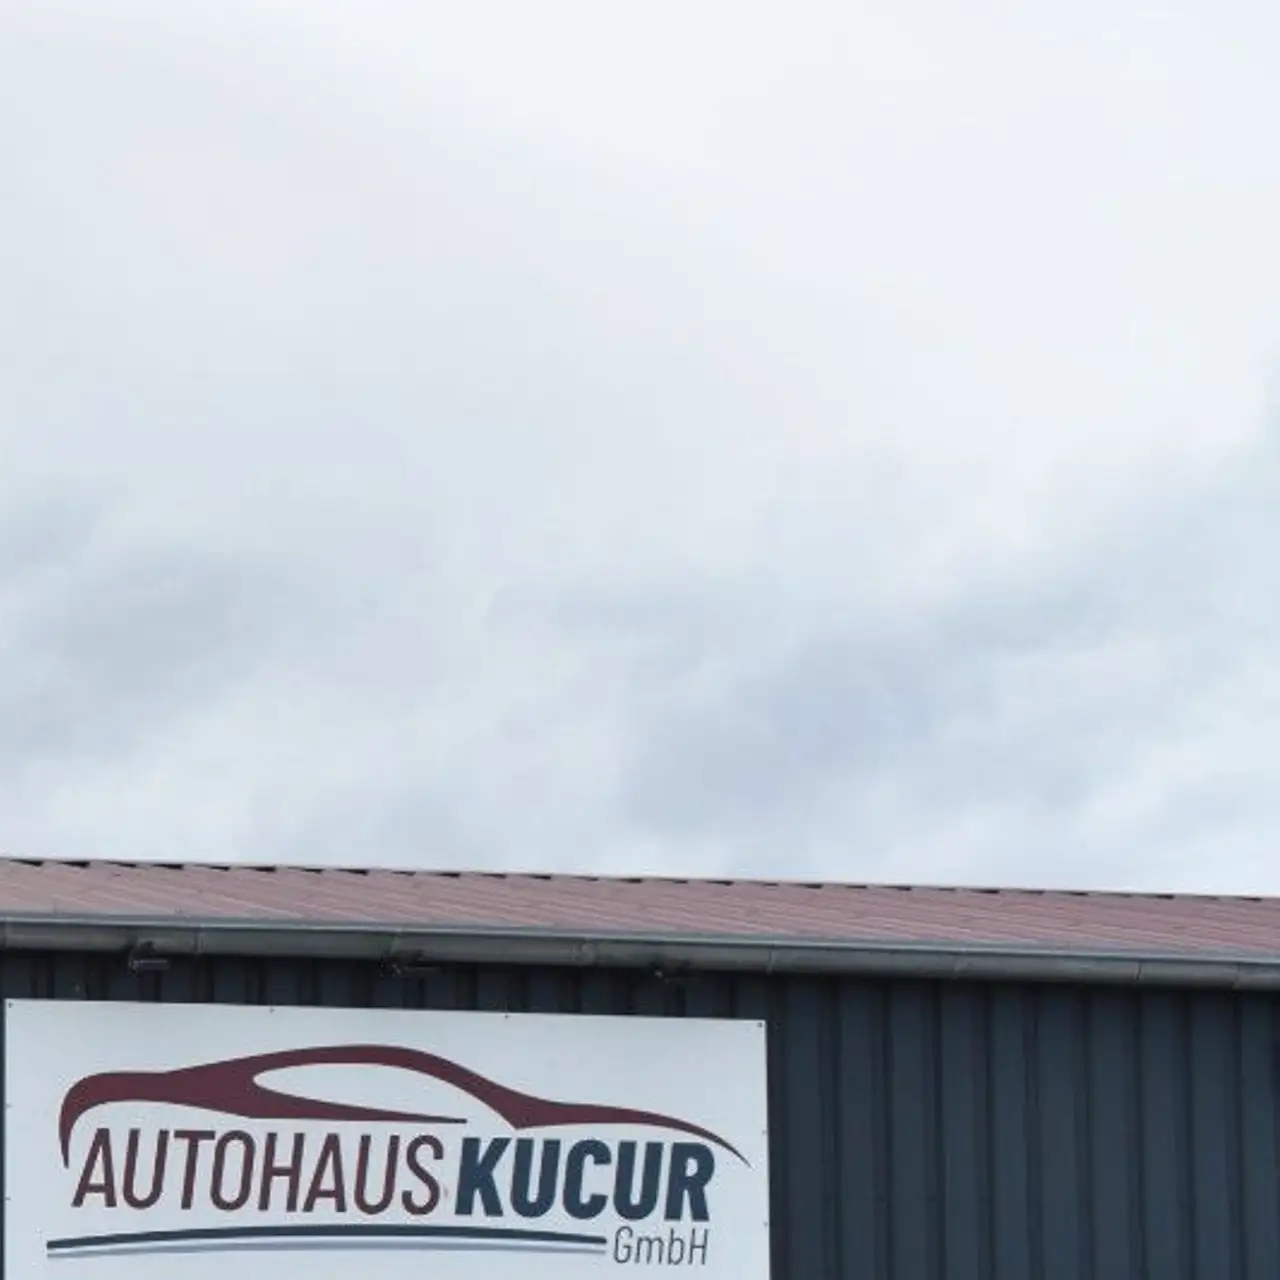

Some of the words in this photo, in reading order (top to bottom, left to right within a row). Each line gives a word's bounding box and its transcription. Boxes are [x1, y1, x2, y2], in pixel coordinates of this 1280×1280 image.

[70, 1127, 444, 1216] AUTOHAUS
[454, 1136, 716, 1223] KUCUR
[612, 1225, 710, 1266] GmbH
